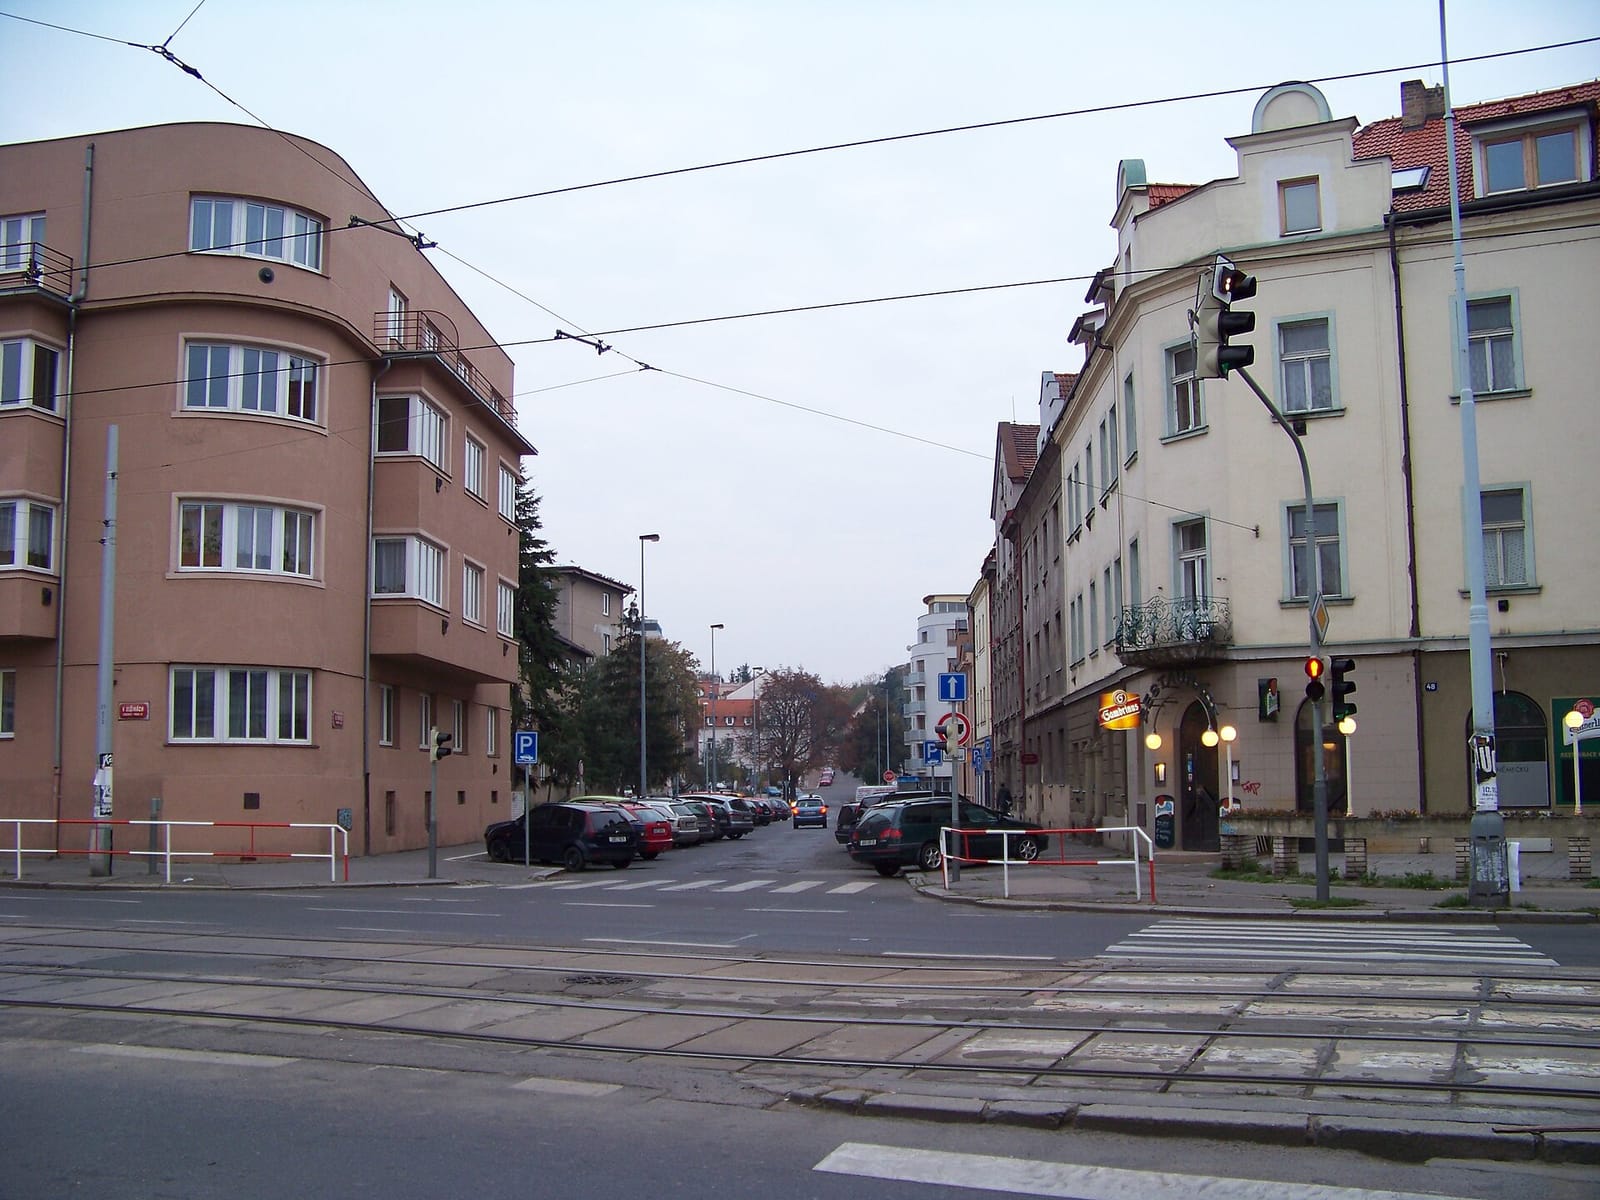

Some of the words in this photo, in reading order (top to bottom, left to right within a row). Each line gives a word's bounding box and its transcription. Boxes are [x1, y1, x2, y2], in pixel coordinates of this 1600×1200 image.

[1101, 703, 1139, 721] Gambrinus
[520, 736, 533, 753] P
[927, 743, 938, 758] P
